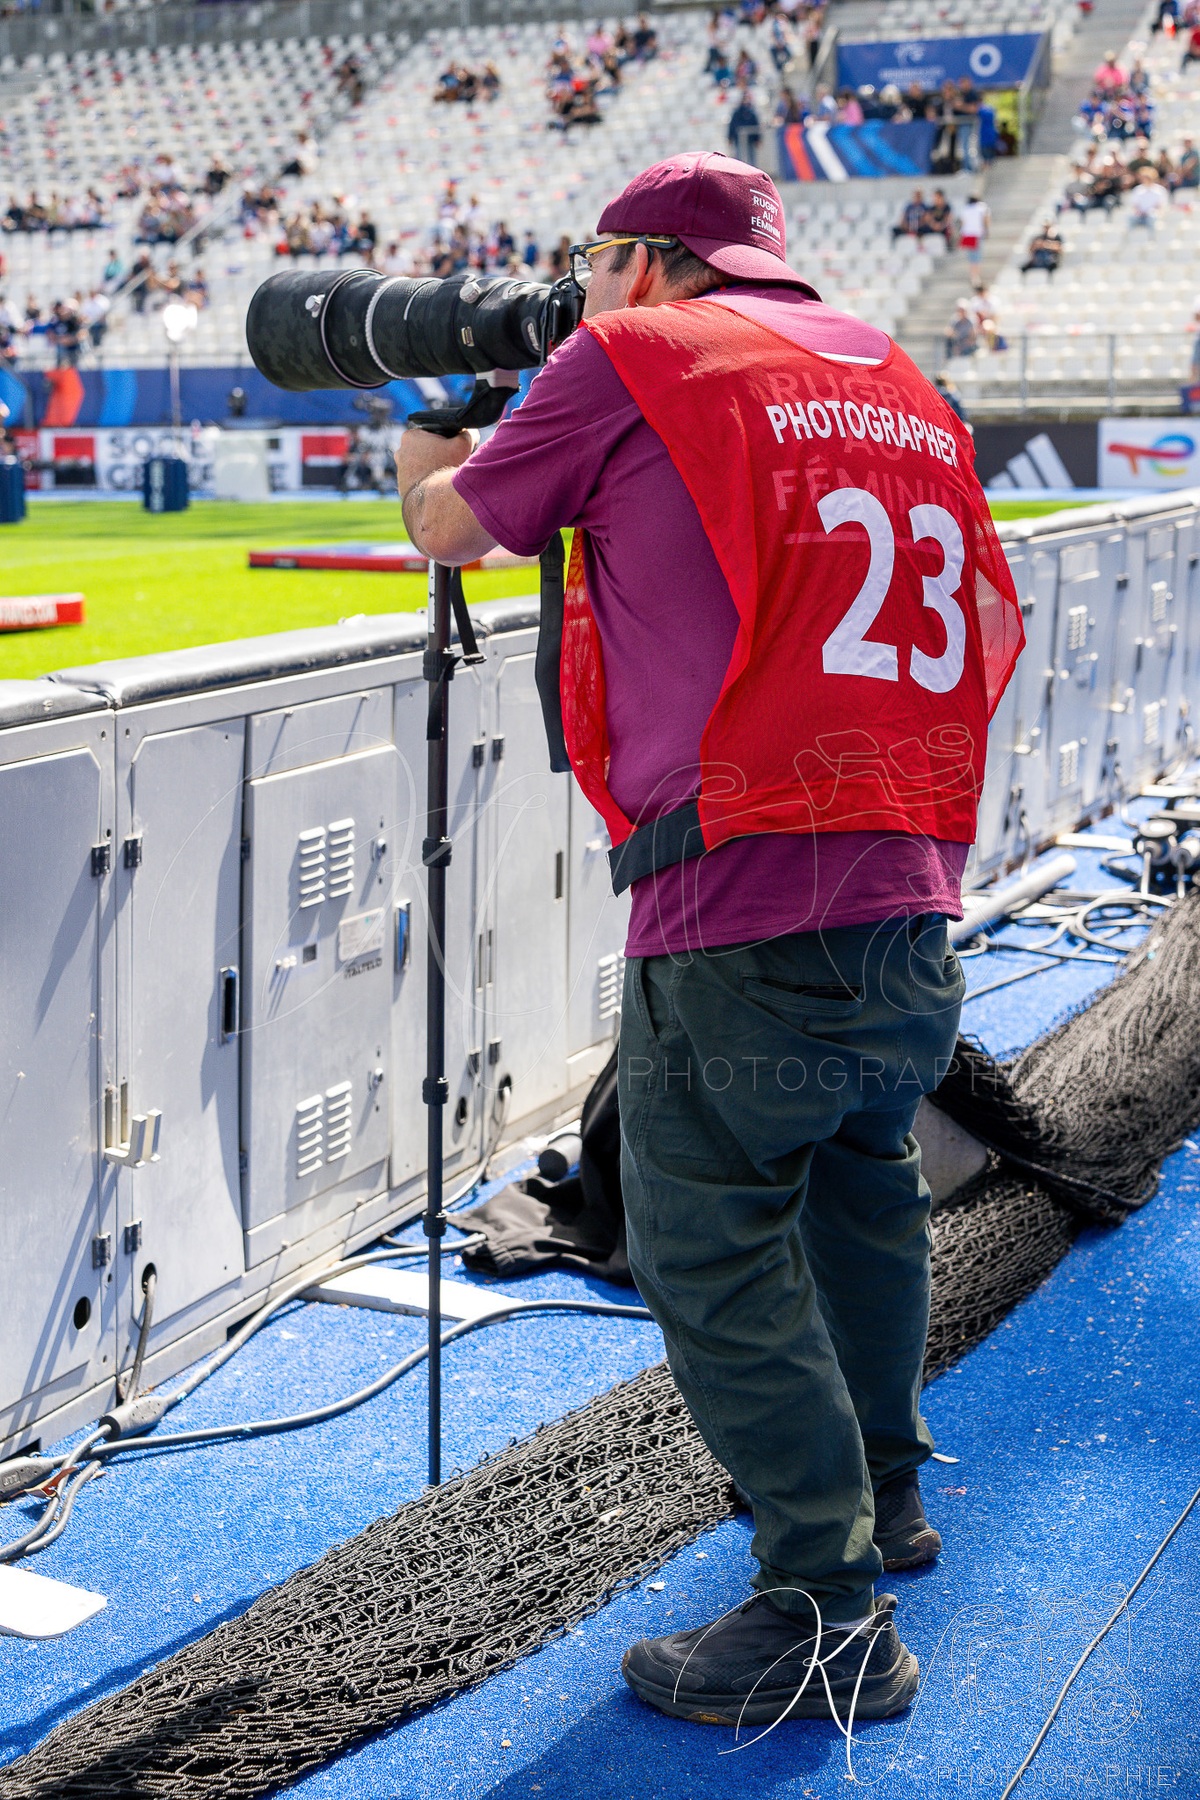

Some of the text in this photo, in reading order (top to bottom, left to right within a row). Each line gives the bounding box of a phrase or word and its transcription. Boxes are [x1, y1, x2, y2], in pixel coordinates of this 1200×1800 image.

[753, 195, 778, 216] RUGBY
[763, 211, 773, 223] AU
[767, 372, 924, 416] RUGBY
[766, 400, 958, 468] PHOTOGRAPHER
[816, 487, 966, 693] 23
